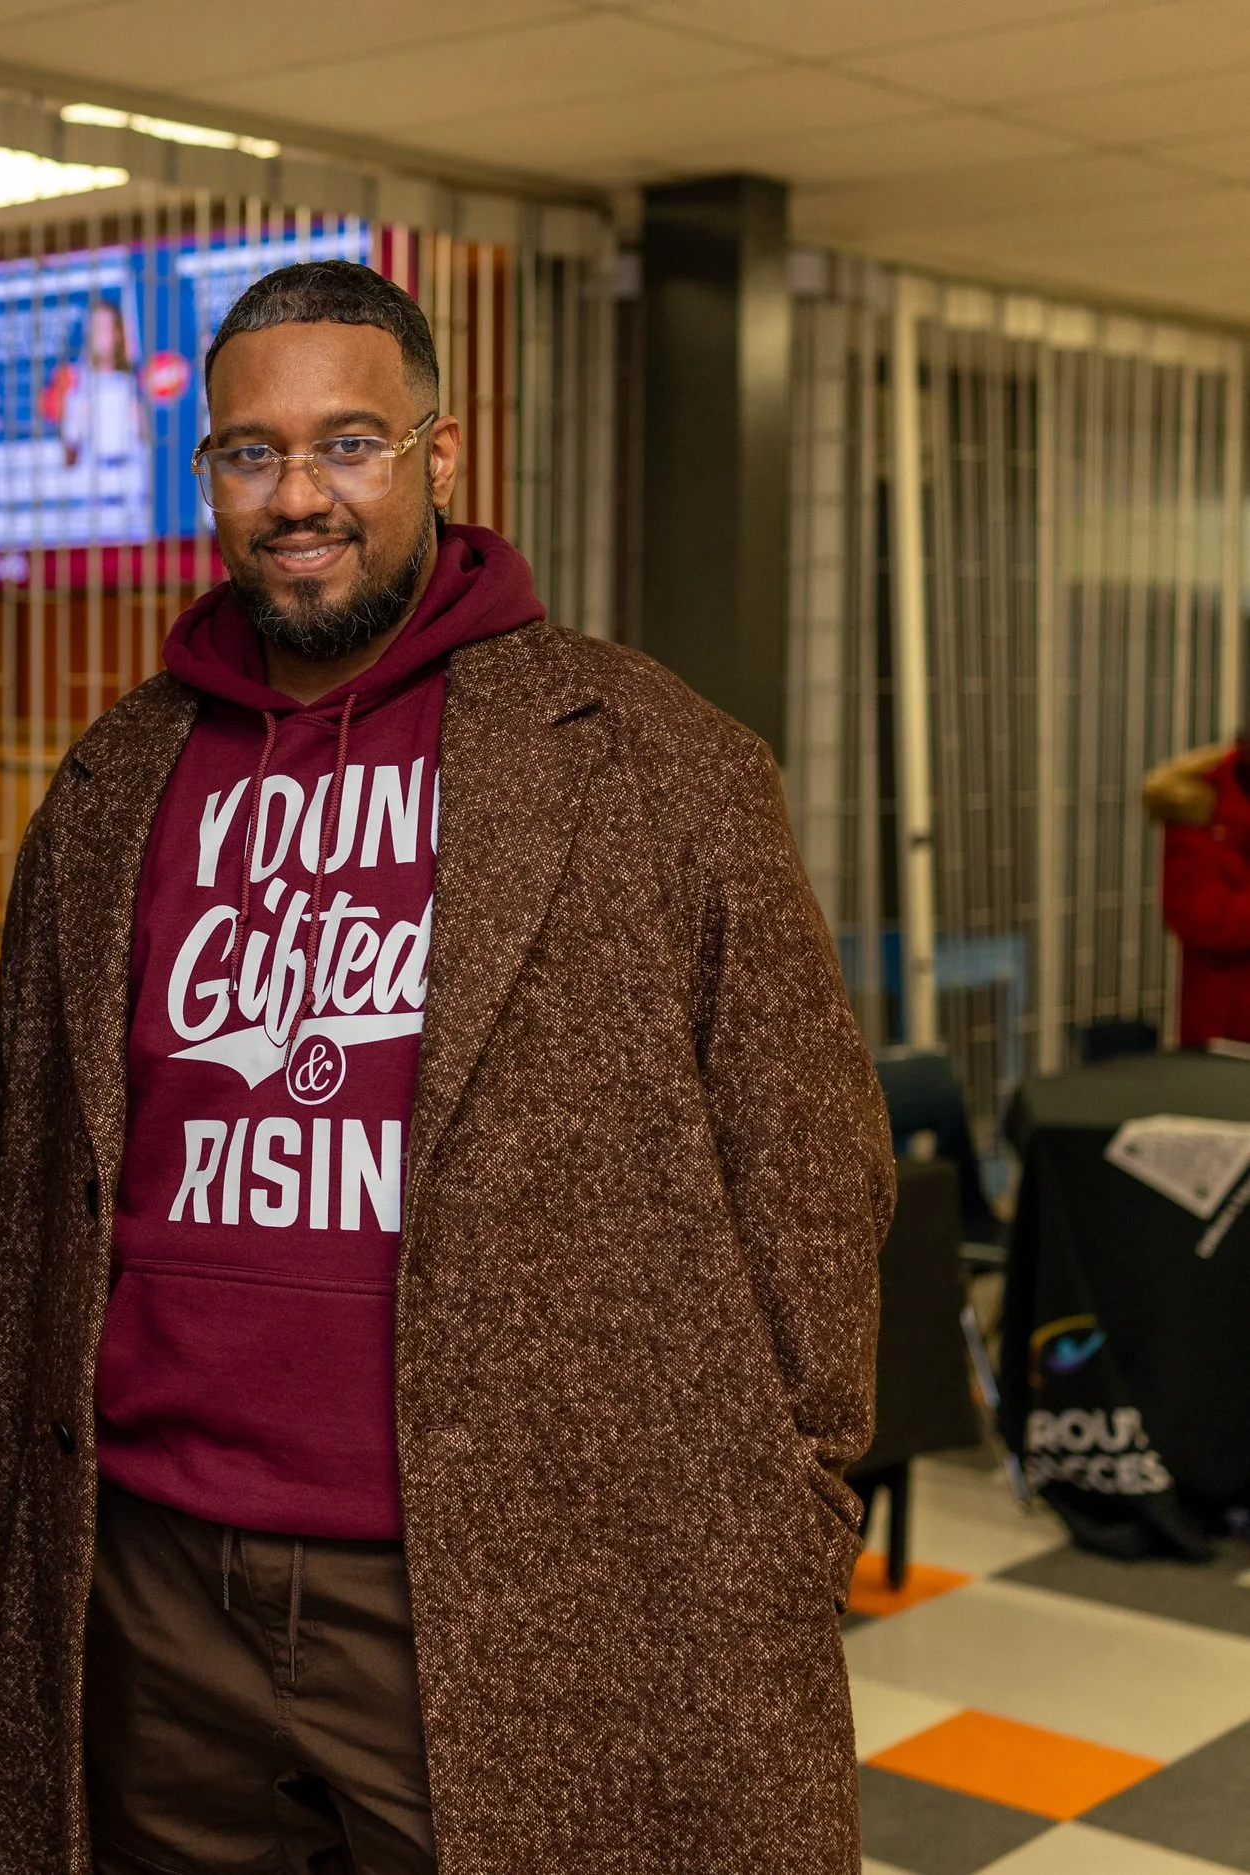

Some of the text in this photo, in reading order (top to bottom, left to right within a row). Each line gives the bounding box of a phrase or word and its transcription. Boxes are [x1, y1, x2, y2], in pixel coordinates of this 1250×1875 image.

[196, 757, 440, 887] YOUN
[168, 878, 434, 1046] Gifted
[294, 1043, 334, 1092] &
